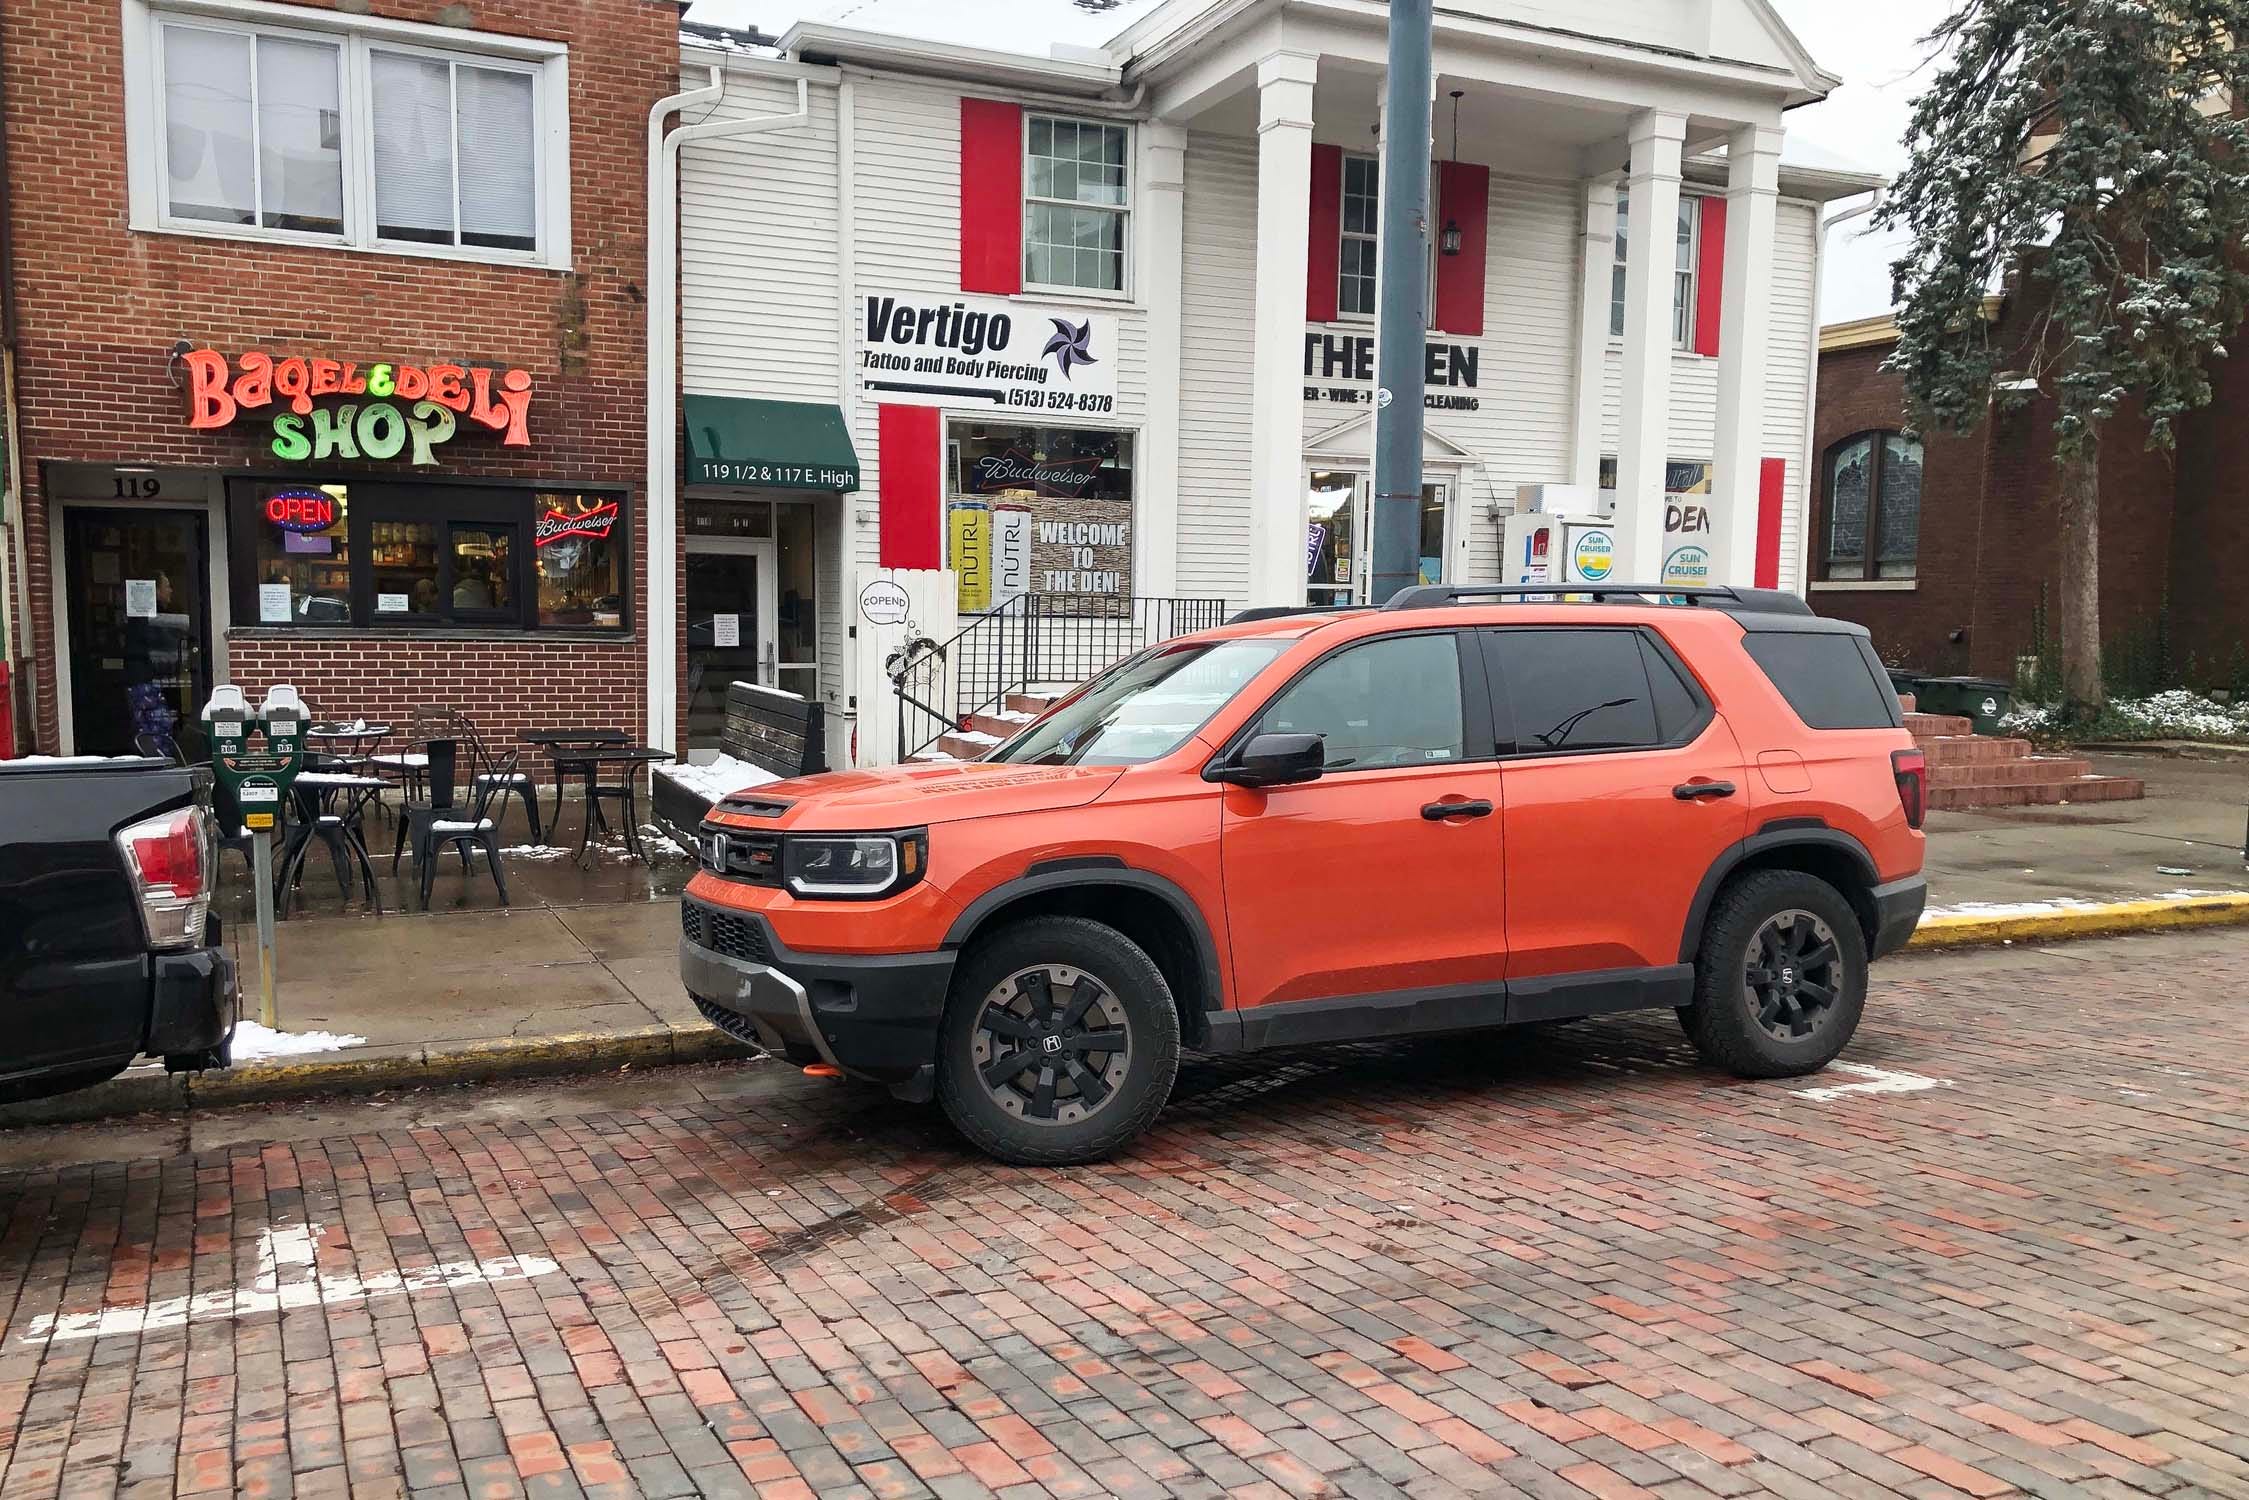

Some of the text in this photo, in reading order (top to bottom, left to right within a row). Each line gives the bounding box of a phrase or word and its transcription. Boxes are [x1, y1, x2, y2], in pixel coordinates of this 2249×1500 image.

[867, 296, 1011, 355] Vertigo
[863, 350, 1049, 385] Tattoo and Body Piercing
[1304, 333, 1478, 387] THE EN
[368, 364, 395, 397] &
[1008, 388, 1113, 412] (513) 524-8378
[1424, 395, 1479, 411] CLEANING
[271, 402, 457, 466] SHOP
[703, 464, 854, 488] 119 1/2 & 117 E. High
[979, 456, 1097, 486] Budweiser
[112, 477, 160, 498] 119
[269, 497, 333, 522] OPEN
[536, 515, 617, 537] Budweiser
[1039, 522, 1127, 545] WELCOME
[1580, 545, 1611, 553] CRUISER
[1588, 536, 1604, 544] SUN
[1071, 547, 1094, 569] TO
[1679, 554, 1700, 563] SUN
[1043, 570, 1120, 593] THE DEN!
